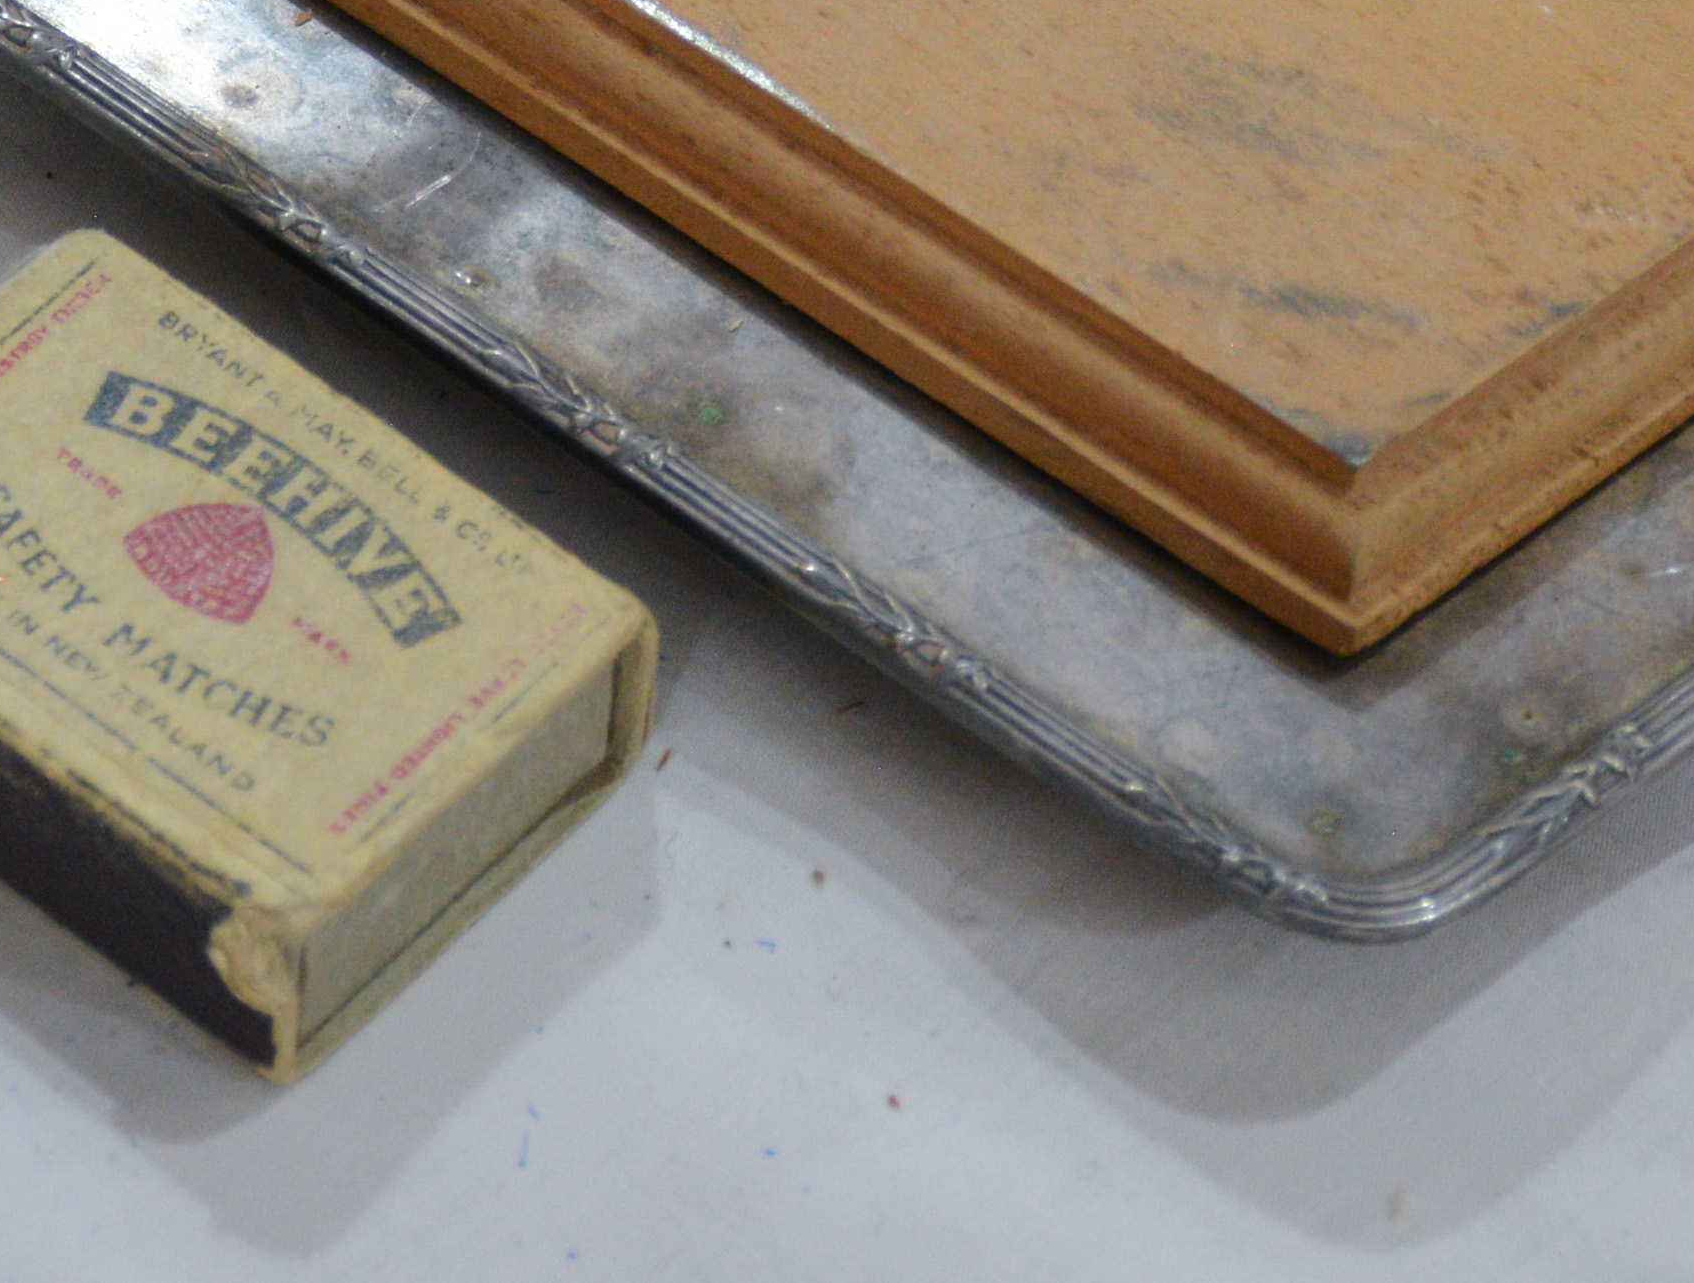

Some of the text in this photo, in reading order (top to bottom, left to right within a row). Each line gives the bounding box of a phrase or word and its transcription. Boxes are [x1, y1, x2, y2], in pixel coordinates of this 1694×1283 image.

[158, 311, 264, 387] BRYANT
[356, 448, 420, 506] BELL
[433, 504, 453, 523] &
[57, 447, 123, 499] TRADE
[103, 379, 452, 634] BEEHIVE
[102, 623, 337, 747] MATCHES
[290, 615, 353, 664] MARK
[7, 609, 41, 637] IN
[44, 634, 108, 682] NEW
[110, 683, 256, 793] ZEALAND
[390, 712, 467, 781] LIGHTED
[329, 780, 389, 834] FIRES
